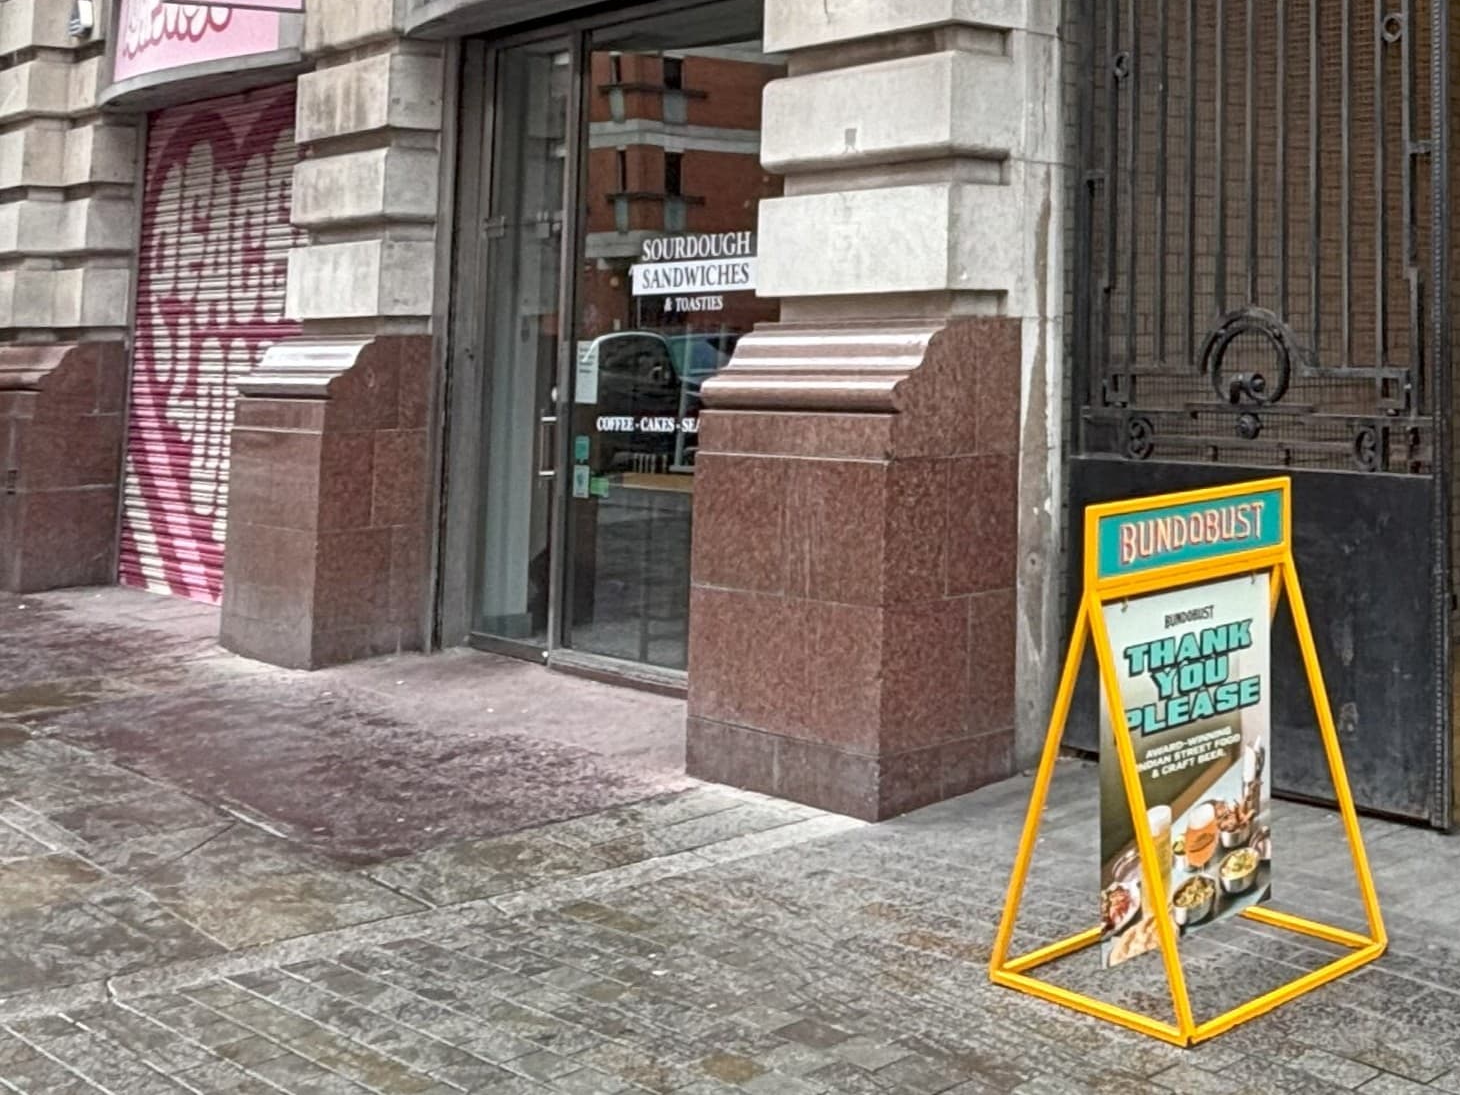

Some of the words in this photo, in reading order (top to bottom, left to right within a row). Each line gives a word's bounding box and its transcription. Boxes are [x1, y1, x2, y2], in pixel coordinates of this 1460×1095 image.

[642, 231, 751, 261] SOURDOUGH
[642, 263, 750, 290] SANDWICHES
[664, 296, 673, 312] &
[675, 296, 724, 312] TOASTIES
[596, 416, 635, 432] COFFEE
[640, 417, 675, 432] CAKES
[1119, 500, 1266, 566] BUNDOBUST
[1164, 605, 1214, 629] BUNDOBUST
[1123, 618, 1254, 678] THANK
[1150, 655, 1230, 701] YOU
[1124, 675, 1261, 737] PLEASE
[1173, 742, 1212, 762] STREET
[1161, 757, 1195, 775] CRAFT
